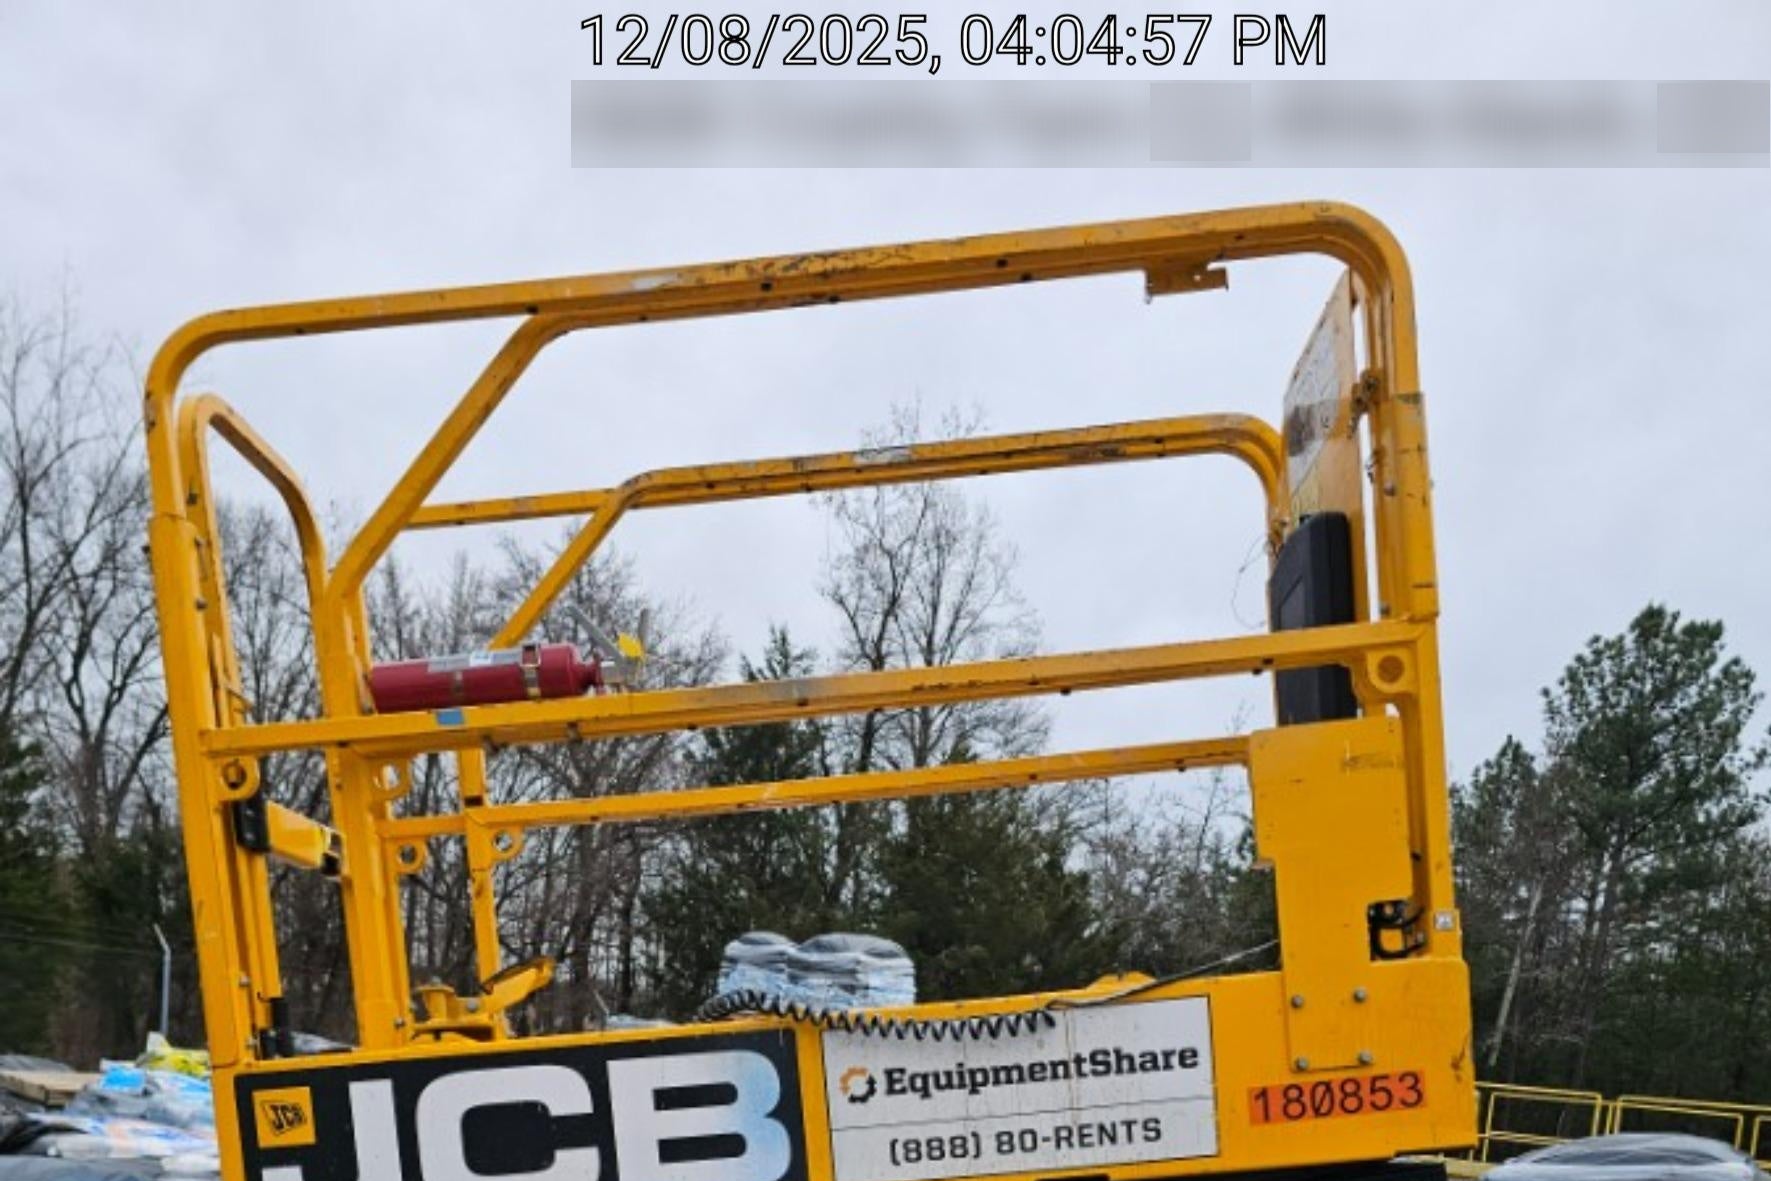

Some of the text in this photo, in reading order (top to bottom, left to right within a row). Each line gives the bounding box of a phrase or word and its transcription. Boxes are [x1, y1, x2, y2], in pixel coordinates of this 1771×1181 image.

[883, 1045, 1200, 1100] EquipmentShare
[1252, 1072, 1425, 1122] 180853
[888, 1117, 1163, 1168] (888) 80-RENTS
